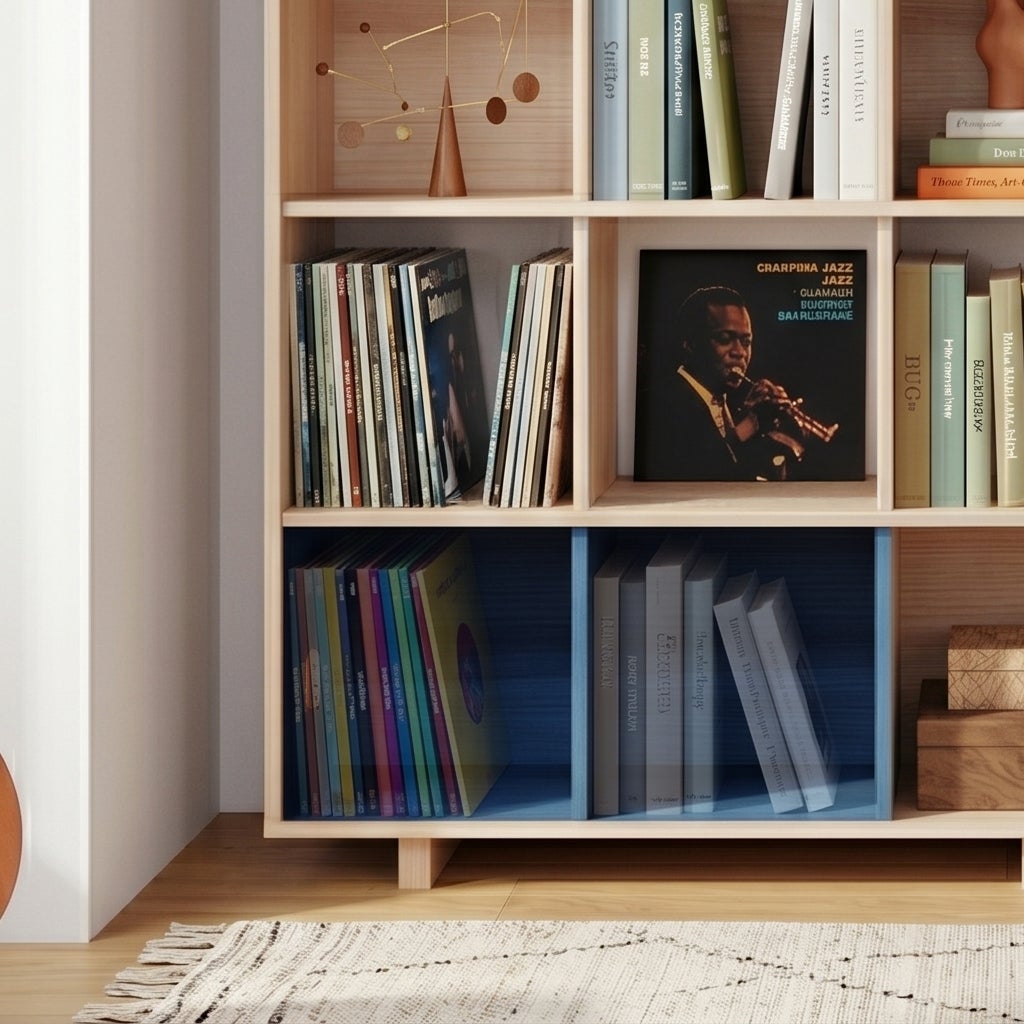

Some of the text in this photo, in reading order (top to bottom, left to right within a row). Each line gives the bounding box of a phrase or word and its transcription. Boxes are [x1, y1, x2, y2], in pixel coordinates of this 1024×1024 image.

[966, 177, 997, 188] Times,
[822, 262, 854, 273] JAZZ
[821, 275, 854, 285] JAZZ
